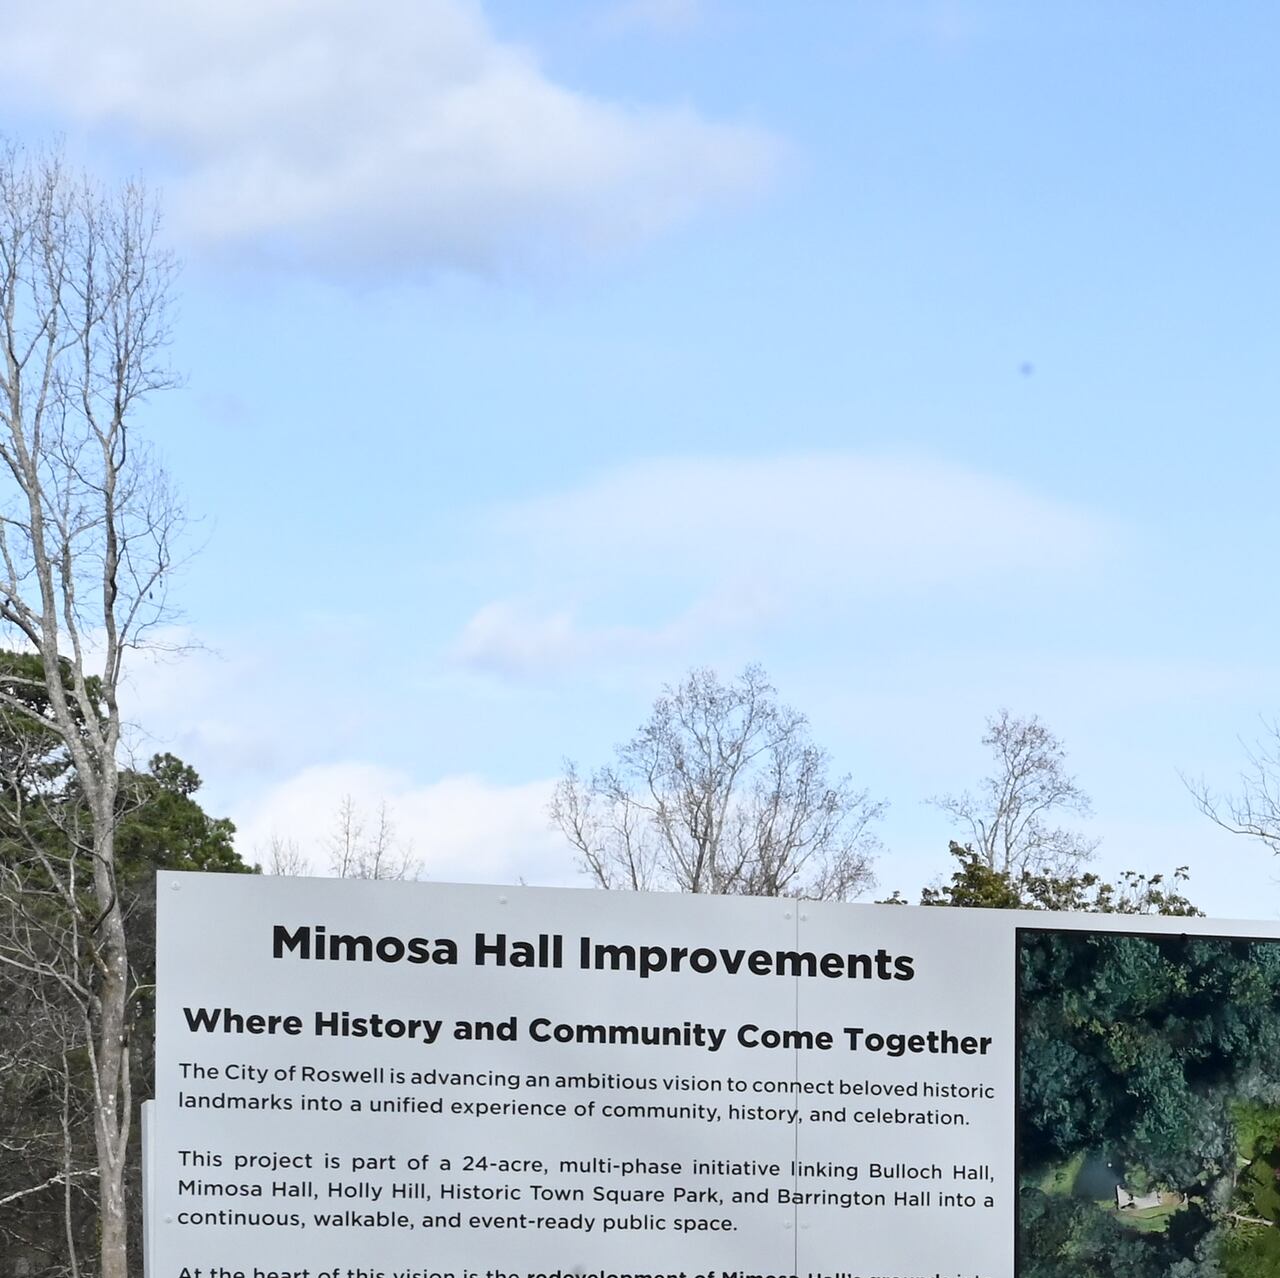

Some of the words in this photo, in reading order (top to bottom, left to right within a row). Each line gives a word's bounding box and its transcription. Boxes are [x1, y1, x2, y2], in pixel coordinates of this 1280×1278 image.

[272, 924, 458, 966] Mimosa
[474, 932, 563, 969] Hall
[579, 936, 915, 982] Improvements
[182, 1007, 304, 1036] Where
[314, 1010, 443, 1045] History
[453, 1015, 518, 1042] and
[528, 1017, 727, 1053] Community
[736, 1023, 834, 1051] Come
[842, 1027, 993, 1058] Together
[178, 1062, 220, 1080] The
[224, 1063, 269, 1085] City
[273, 1064, 297, 1082] of
[301, 1065, 384, 1084] Roswell
[389, 1067, 406, 1085] is
[410, 1068, 521, 1091] advancing
[525, 1075, 550, 1088] an
[554, 1072, 658, 1091] ambitious
[662, 1074, 722, 1092] vision
[727, 1077, 748, 1093] to
[752, 1080, 835, 1095] connect
[839, 1079, 918, 1097] beloved
[923, 1081, 995, 1100] historic
[178, 1091, 293, 1111] landmarks
[301, 1094, 343, 1112] into
[349, 1099, 362, 1112] a
[369, 1096, 443, 1114] unified
[450, 1099, 567, 1118] experience
[573, 1100, 596, 1117] of
[601, 1103, 721, 1123] community,
[728, 1103, 803, 1125] history,
[809, 1106, 847, 1123] and
[853, 1107, 970, 1126] celebration.
[177, 1149, 223, 1168] This
[234, 1151, 313, 1172] project
[324, 1152, 341, 1170] is
[351, 1154, 397, 1173] part
[407, 1154, 430, 1171] of
[439, 1158, 451, 1172] a
[462, 1155, 549, 1176] 24-acre,
[559, 1156, 683, 1177] multi-phase
[692, 1158, 781, 1177] initiative
[791, 1160, 859, 1182] linking
[869, 1162, 943, 1180] Bulloch
[953, 1164, 995, 1184] Hall,
[178, 1179, 263, 1197] Mimosa
[272, 1180, 319, 1201] Hall,
[328, 1181, 383, 1202] Holly
[392, 1182, 431, 1202] Hill,
[440, 1183, 521, 1201] Historic
[529, 1184, 585, 1202] Town
[592, 1185, 665, 1205] Square
[673, 1186, 724, 1206] Park,
[731, 1187, 769, 1204] and
[777, 1188, 886, 1209] Barrington
[894, 1190, 931, 1207] Hall
[938, 1191, 976, 1208] into
[983, 1195, 994, 1208] a
[177, 1208, 306, 1230] continuous,
[313, 1210, 415, 1231] walkable,
[421, 1211, 462, 1229] and
[468, 1213, 596, 1233] event-ready
[603, 1213, 667, 1233] public
[673, 1218, 738, 1234] space.
